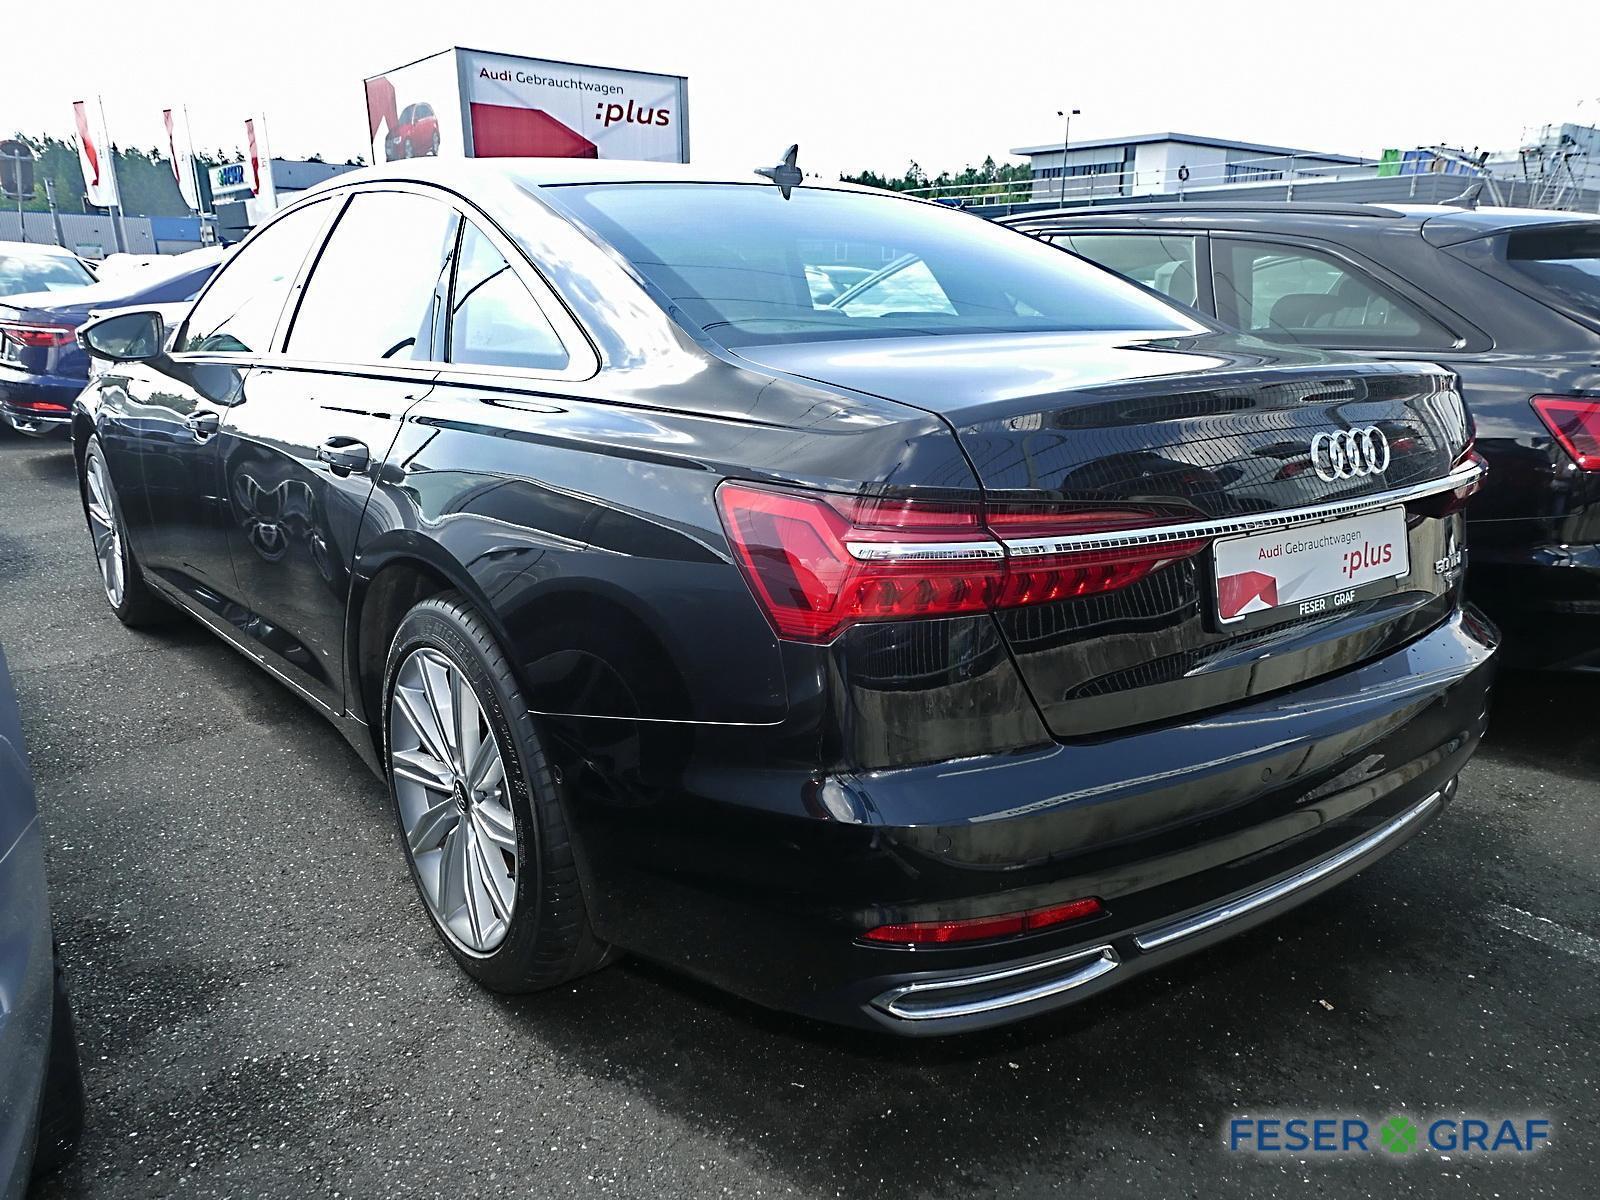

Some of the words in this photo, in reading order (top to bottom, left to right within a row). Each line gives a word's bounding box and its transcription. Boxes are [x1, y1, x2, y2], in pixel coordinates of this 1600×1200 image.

[479, 67, 512, 82] Audi
[516, 72, 624, 95] Gebrauchtwagen
[595, 99, 670, 127] :plus
[1258, 544, 1283, 560] Audi
[1285, 530, 1362, 554] Gebrauchtwagen
[1342, 541, 1392, 578] :plus
[1299, 598, 1326, 615] FESER
[1333, 590, 1356, 606] GRAF
